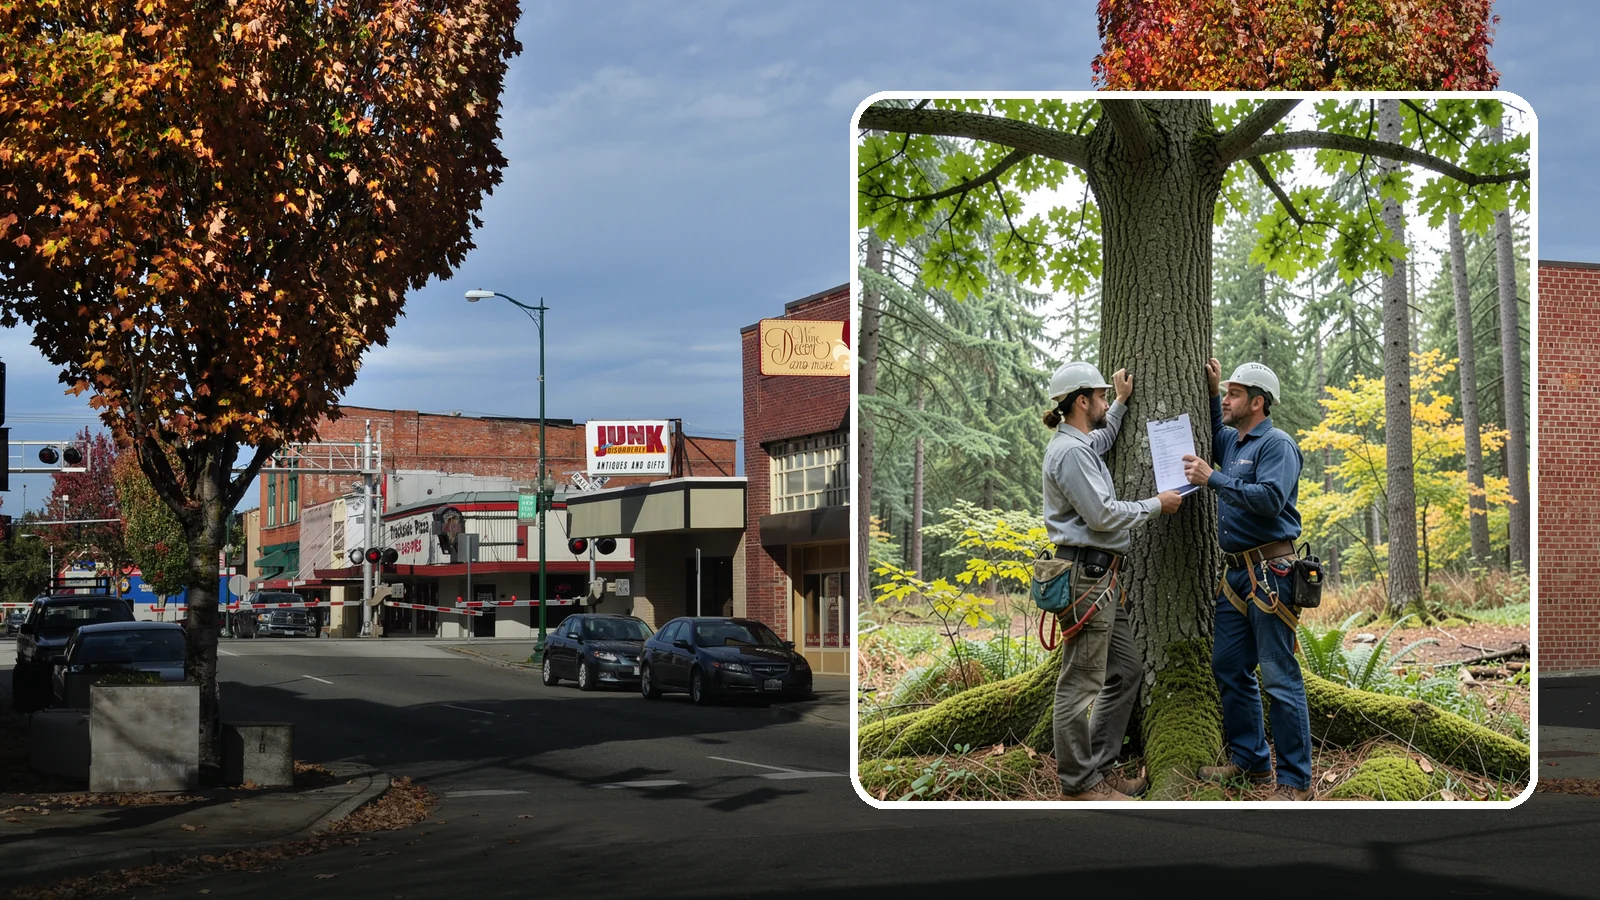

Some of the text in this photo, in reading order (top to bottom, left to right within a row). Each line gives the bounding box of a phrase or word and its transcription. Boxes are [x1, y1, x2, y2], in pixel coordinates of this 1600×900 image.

[595, 425, 665, 457] JUNK
[607, 446, 646, 454] DISORDERLY
[596, 460, 665, 470] ANTIQUES AND GIFTS
[414, 519, 429, 535] Pizza
